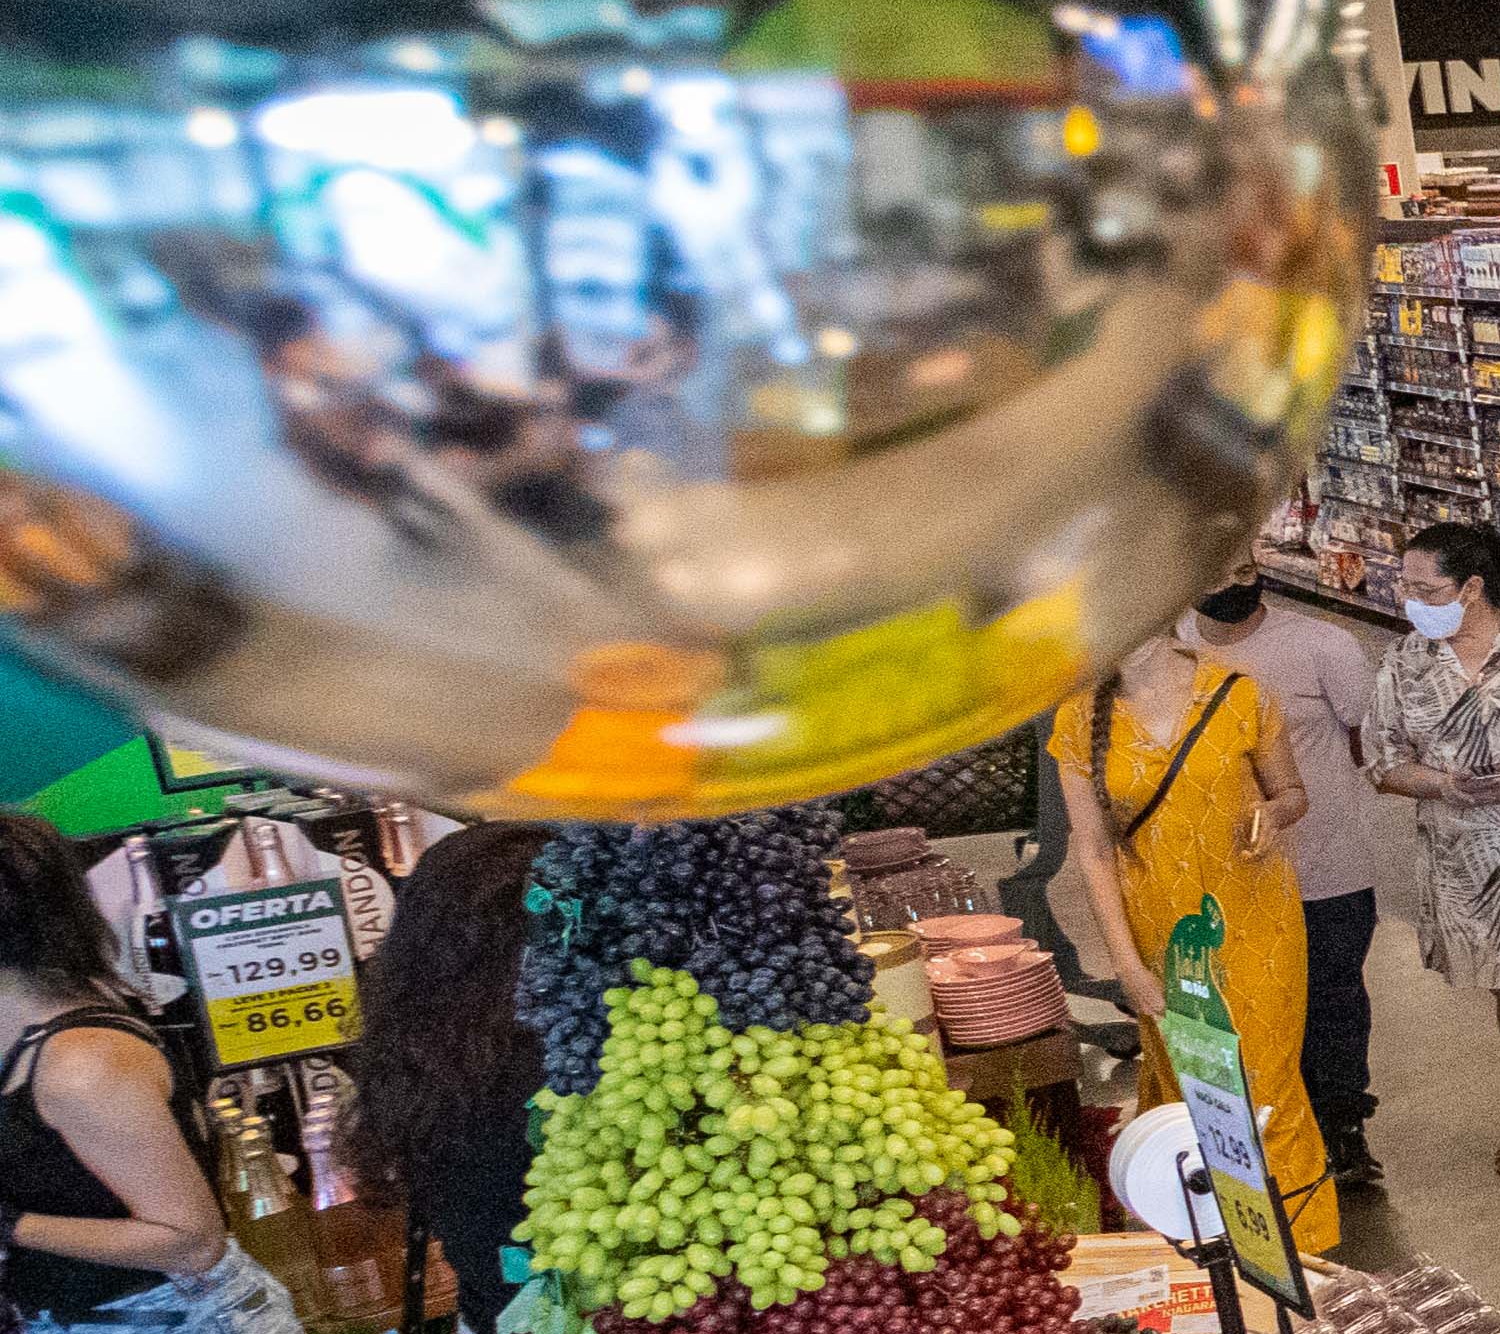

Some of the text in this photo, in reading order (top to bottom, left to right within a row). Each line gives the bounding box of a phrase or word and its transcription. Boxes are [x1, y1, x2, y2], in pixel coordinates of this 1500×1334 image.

[191, 890, 336, 930] OFERTA
[226, 947, 343, 984] 129,99
[245, 1000, 348, 1034] 86,66
[1207, 1124, 1253, 1170] 12,99
[1233, 1198, 1271, 1243] 6,99
